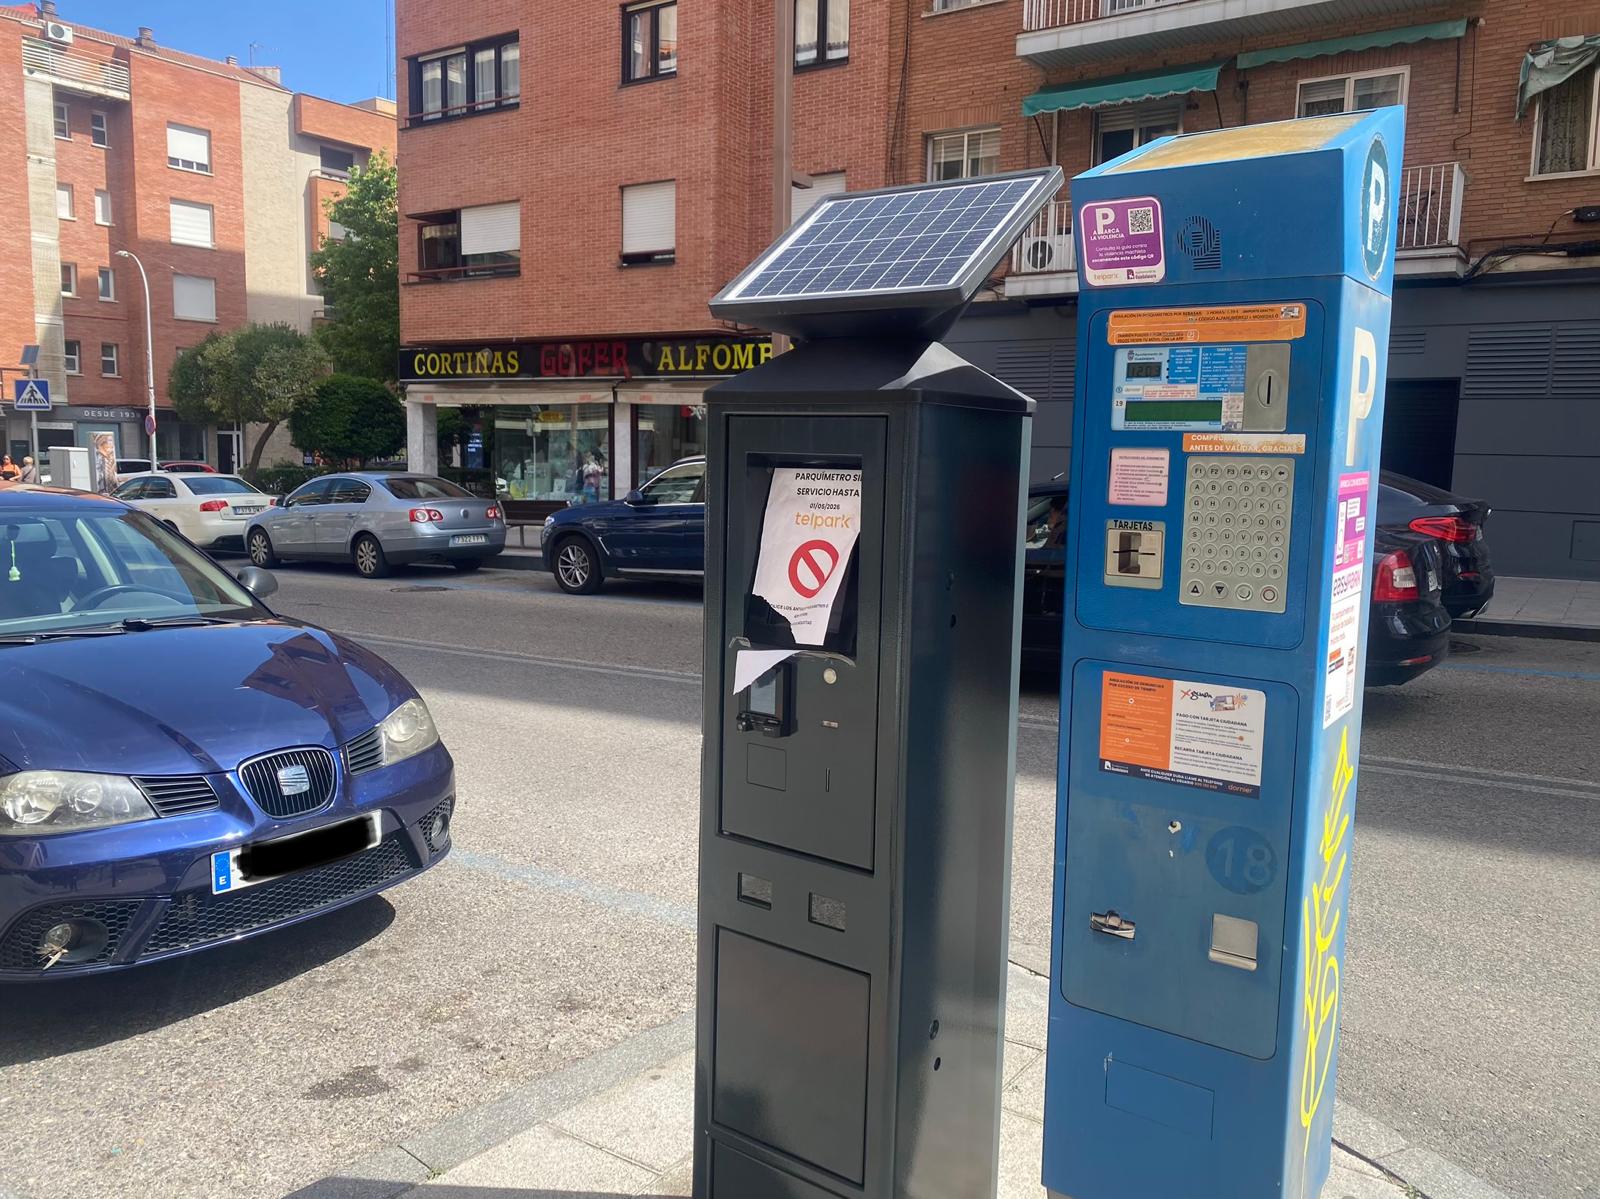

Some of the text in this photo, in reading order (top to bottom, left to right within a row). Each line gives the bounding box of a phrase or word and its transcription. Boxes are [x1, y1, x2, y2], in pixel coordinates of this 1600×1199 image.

[1367, 160, 1386, 254] P
[414, 351, 519, 375] CORTINAS
[1346, 326, 1376, 466] P
[795, 471, 852, 481] PARQUÍMETRO
[797, 488, 860, 497] SERVICIO HASTA
[795, 512, 851, 529] telpark
[1114, 520, 1153, 531] TARJETAS
[1228, 784, 1253, 793] dornier
[1217, 838, 1272, 886] 18
[219, 876, 226, 885] E
